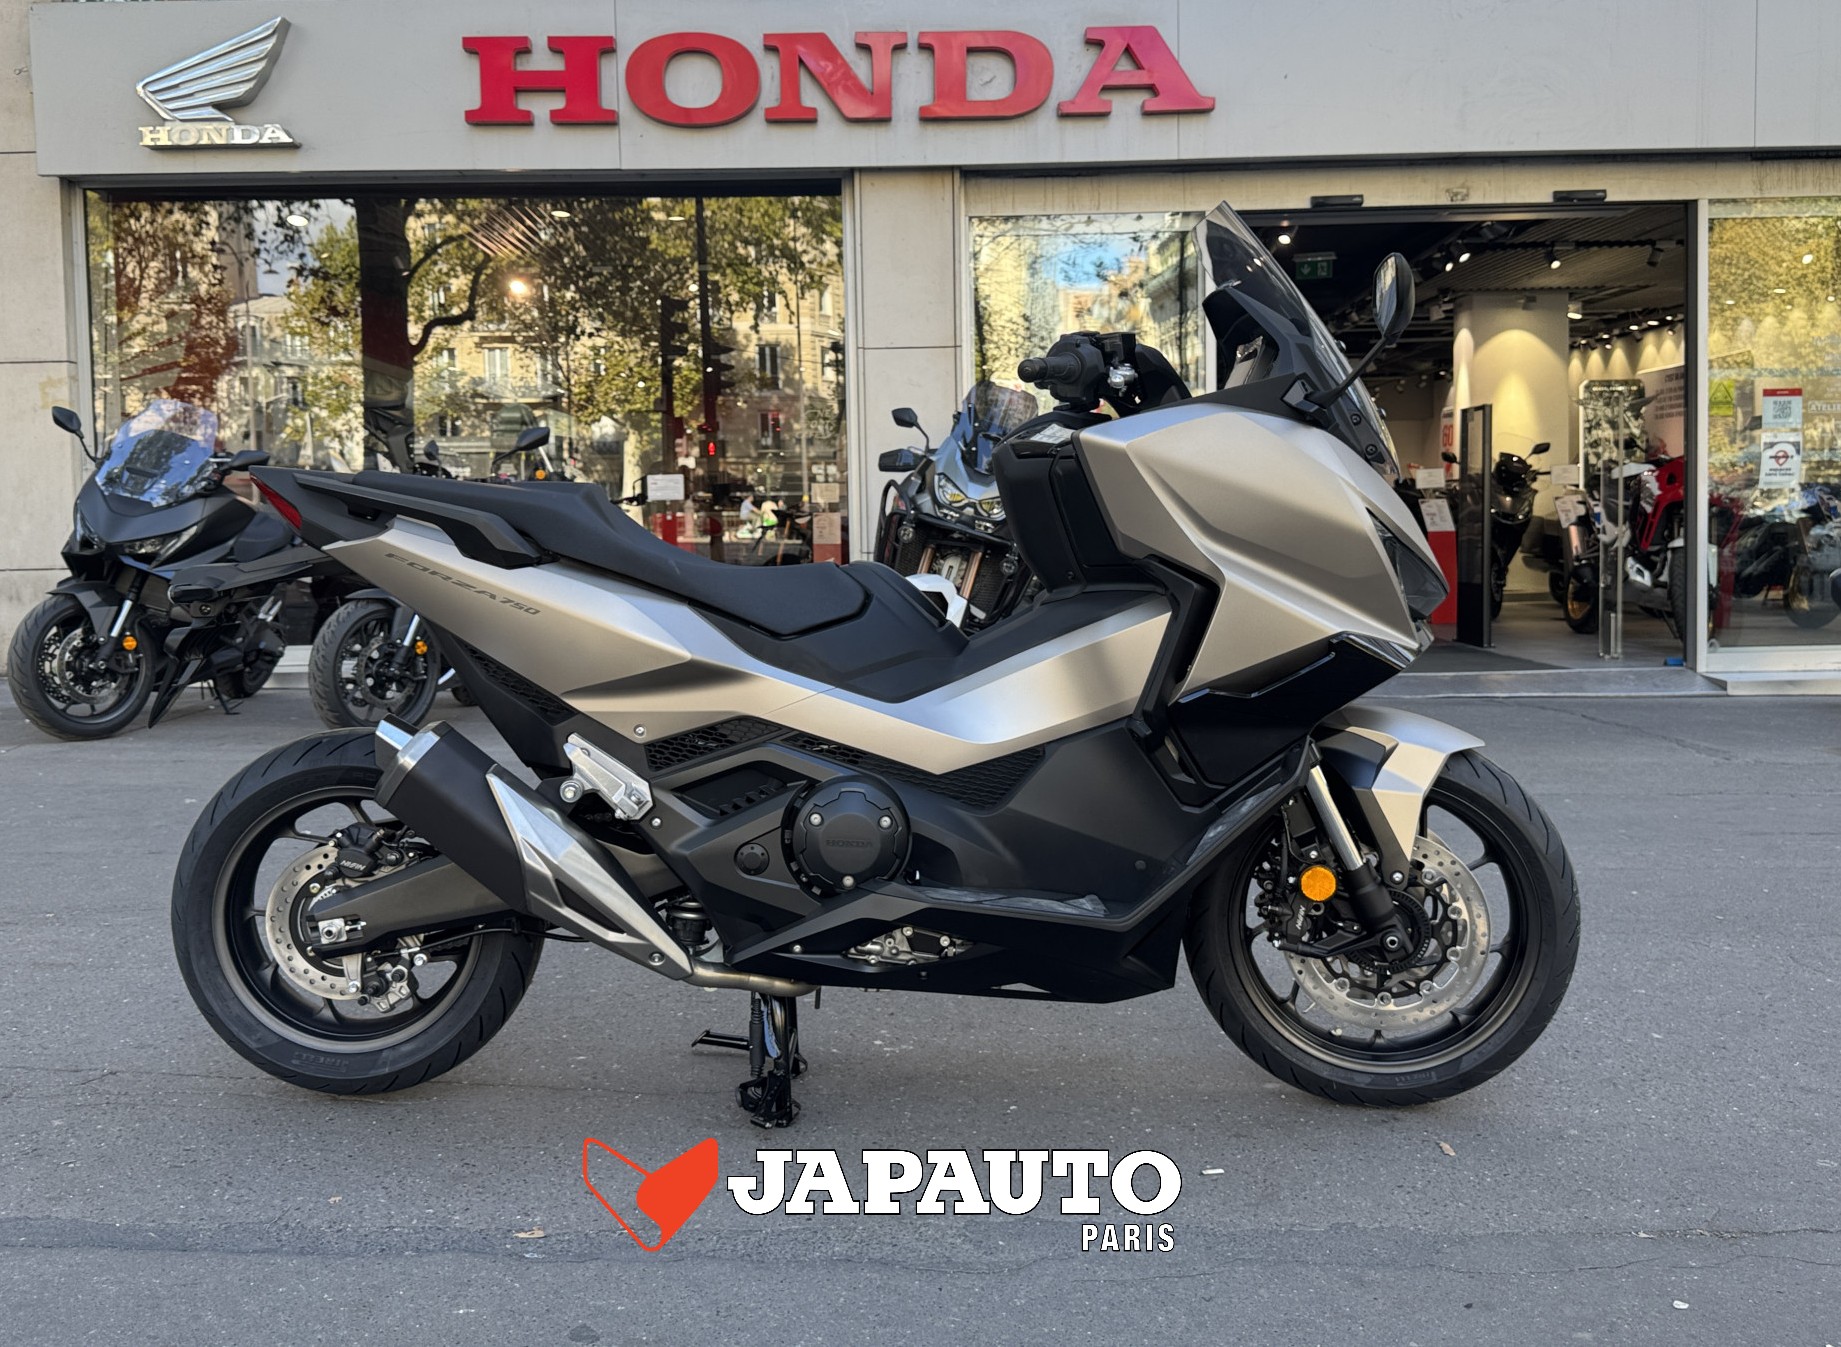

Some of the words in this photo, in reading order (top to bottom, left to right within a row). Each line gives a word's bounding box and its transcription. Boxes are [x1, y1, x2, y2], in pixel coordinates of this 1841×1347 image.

[462, 25, 1216, 127] HONDA
[138, 123, 293, 146] HONDA
[384, 552, 497, 601] FORZA
[500, 597, 541, 616] 750
[825, 839, 874, 848] HONDA
